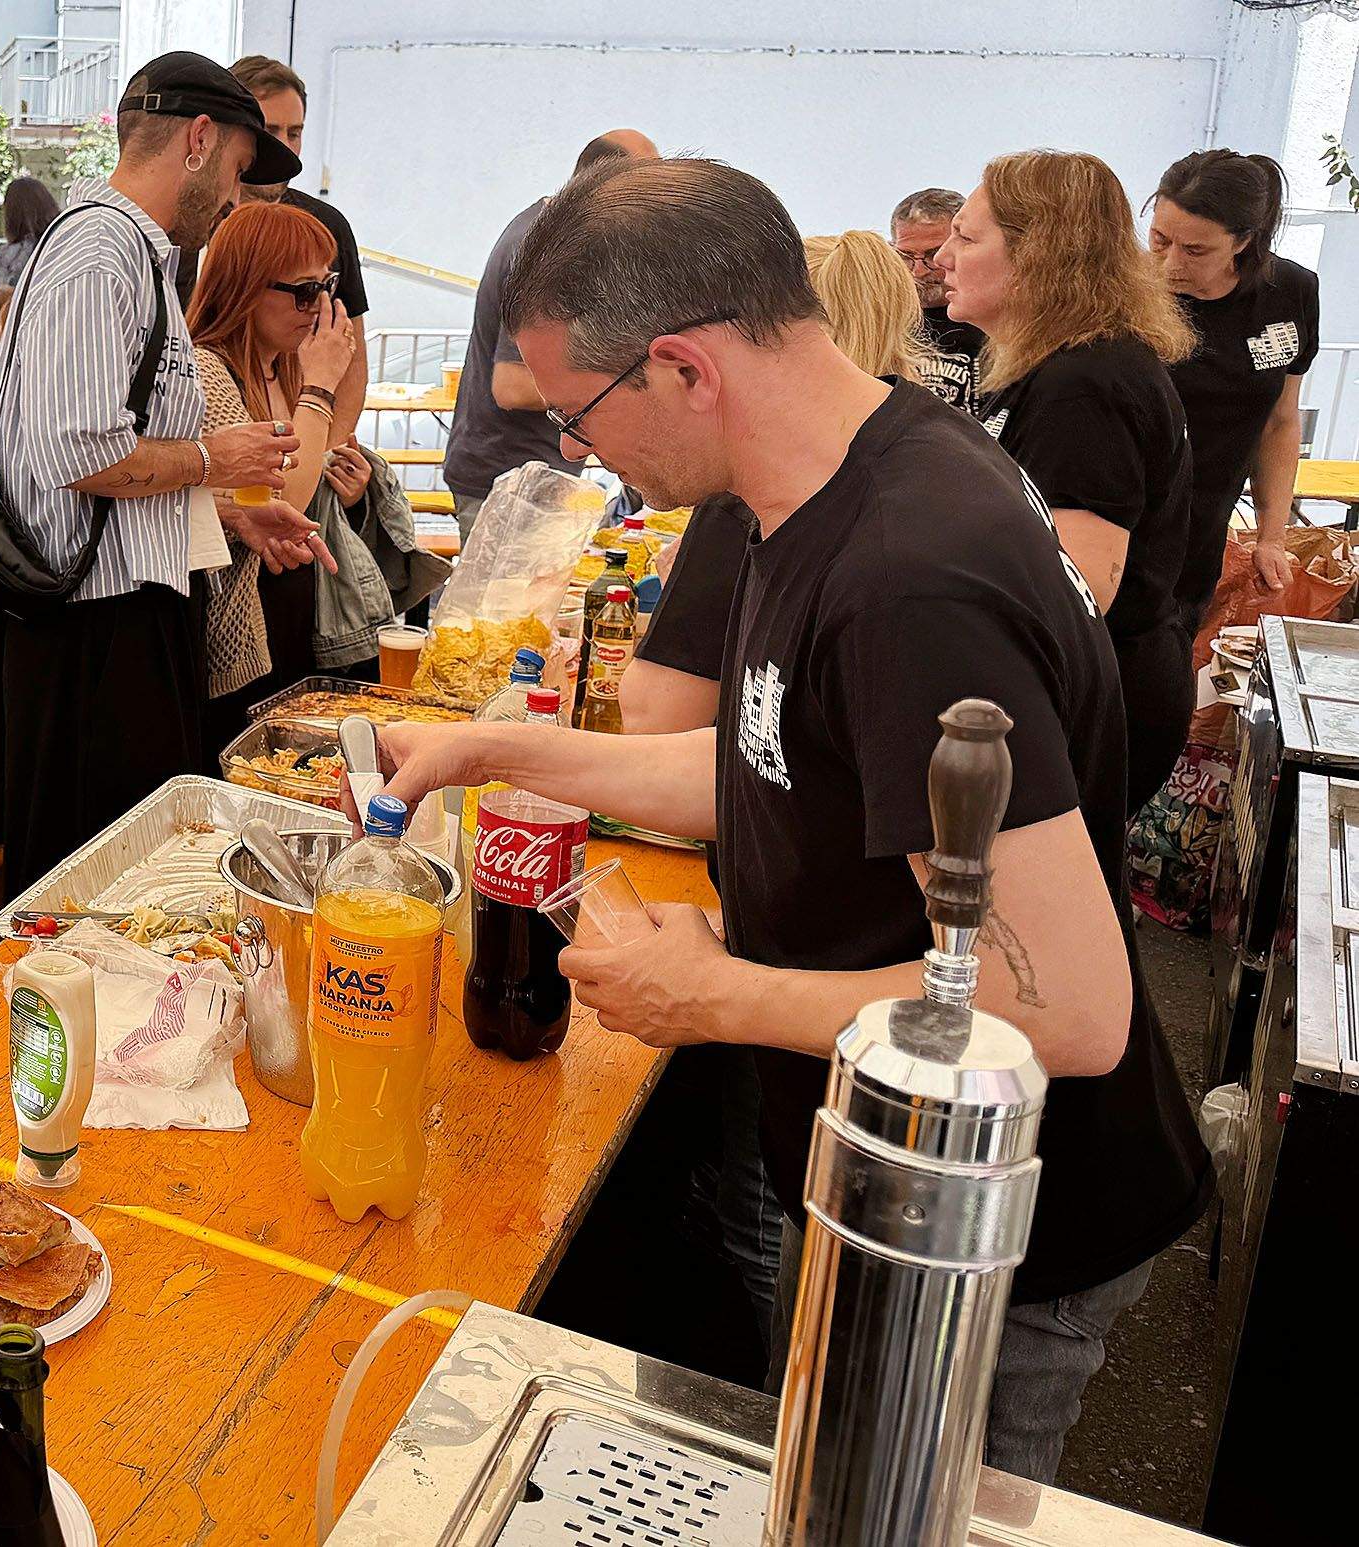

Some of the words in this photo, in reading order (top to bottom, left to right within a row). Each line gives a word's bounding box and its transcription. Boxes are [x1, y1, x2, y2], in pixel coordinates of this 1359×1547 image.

[475, 867, 529, 892] ORIGINAL
[330, 936, 344, 947] MUY
[345, 942, 384, 955] NUESTRO
[326, 960, 386, 996] KAS
[319, 982, 394, 1012] NARANJA
[320, 998, 344, 1013] SABOR
[347, 1009, 393, 1022] ORIGINAL
